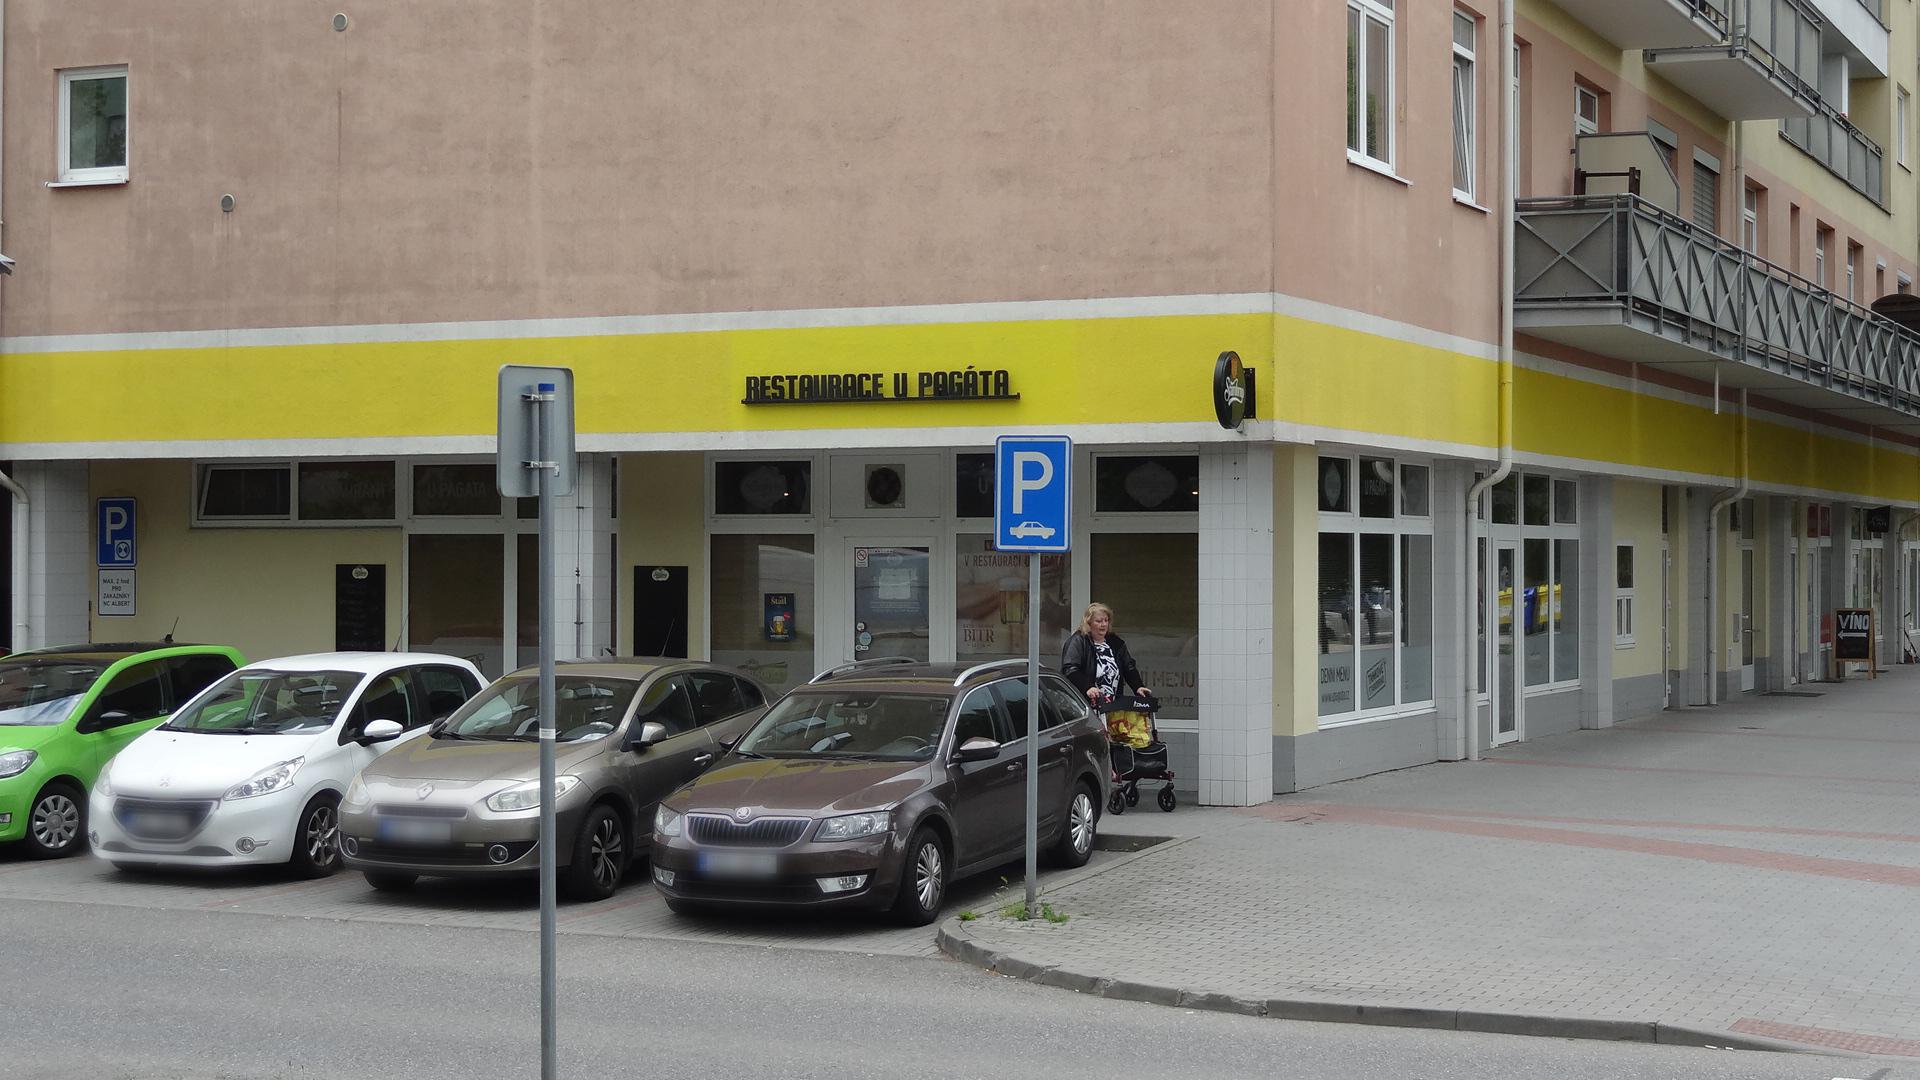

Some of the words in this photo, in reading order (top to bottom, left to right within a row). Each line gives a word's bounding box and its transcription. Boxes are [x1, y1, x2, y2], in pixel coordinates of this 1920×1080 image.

[746, 373, 883, 400] RESTAURACE
[895, 372, 908, 397] U
[918, 365, 1009, 398] PAGÁTA
[1012, 451, 1054, 514] P
[106, 506, 128, 544] P
[964, 554, 970, 567] V
[973, 554, 1022, 568] RESTAURACI
[1838, 612, 1869, 630] VÍNO
[1152, 671, 1195, 688] MENU
[1336, 665, 1351, 683] MENU
